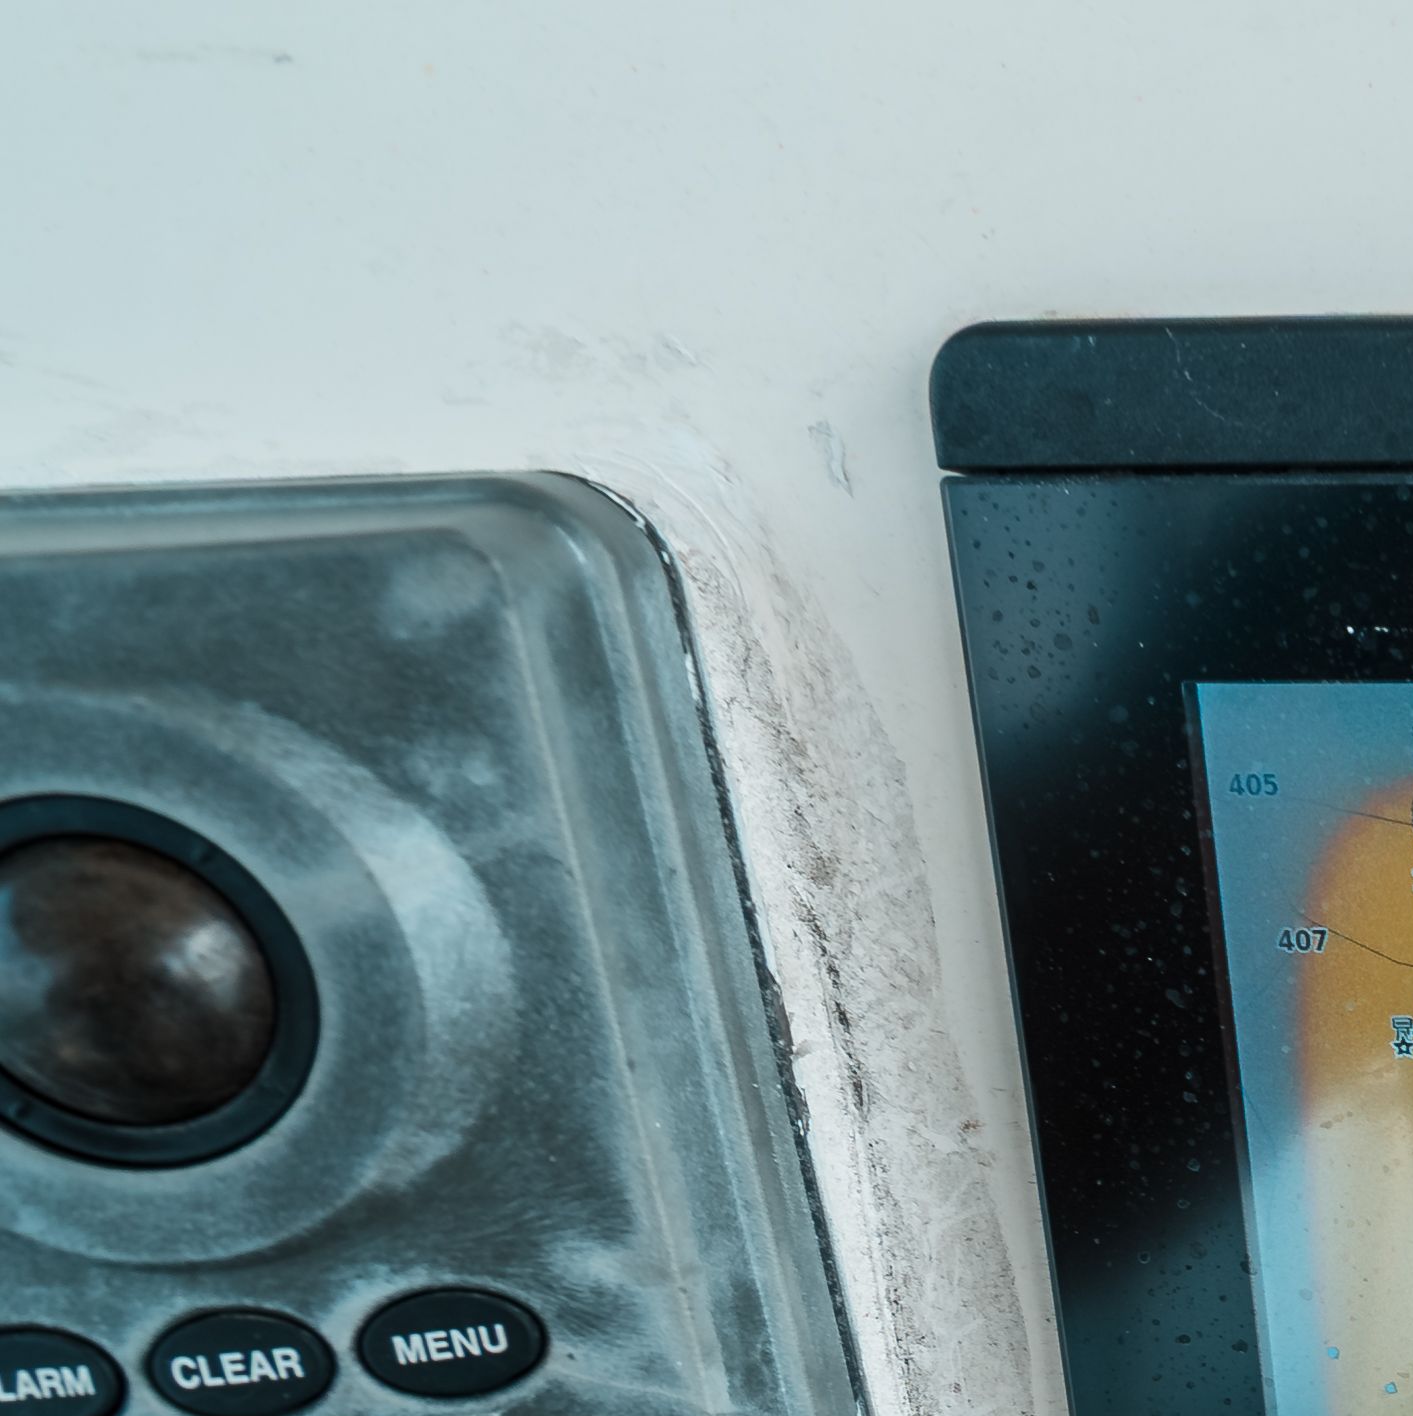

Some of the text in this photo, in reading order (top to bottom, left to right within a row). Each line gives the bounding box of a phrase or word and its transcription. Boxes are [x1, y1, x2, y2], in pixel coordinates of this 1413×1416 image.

[1229, 774, 1278, 797] 405
[1278, 929, 1328, 953] 407
[392, 1324, 508, 1365] MENU
[171, 1348, 305, 1390] CLEAR
